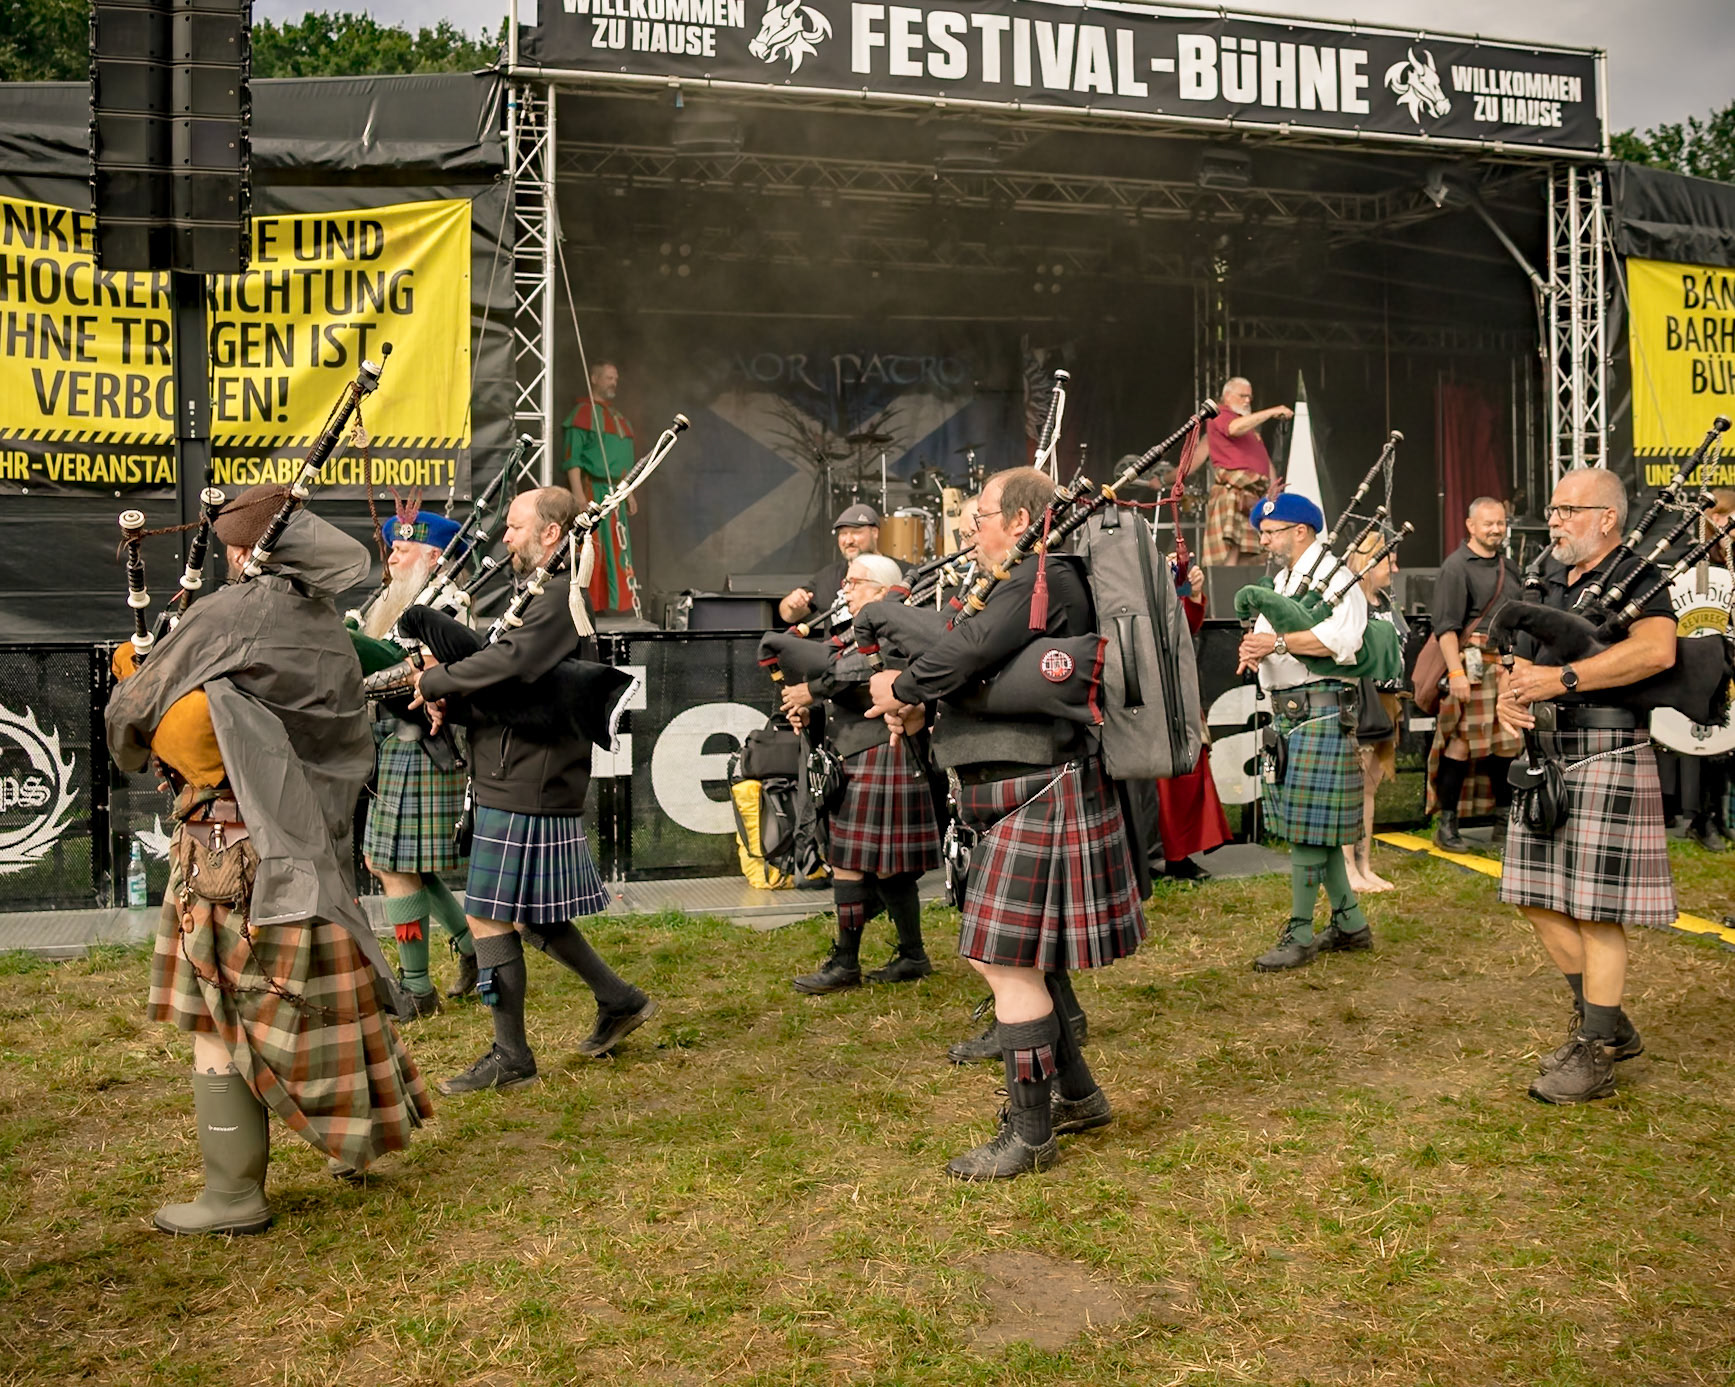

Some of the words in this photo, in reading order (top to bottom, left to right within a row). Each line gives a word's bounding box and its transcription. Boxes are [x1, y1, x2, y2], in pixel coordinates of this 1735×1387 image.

[592, 17, 626, 50] ZU
[632, 20, 716, 57] HAUSE
[1451, 65, 1582, 102] WILLKOMMEN
[1473, 95, 1499, 122] ZU
[1501, 97, 1562, 127] HAUSE
[294, 219, 384, 262] UND
[111, 316, 294, 369] TRGEN
[310, 322, 377, 368] IST
[31, 367, 289, 423] VERBOEN!
